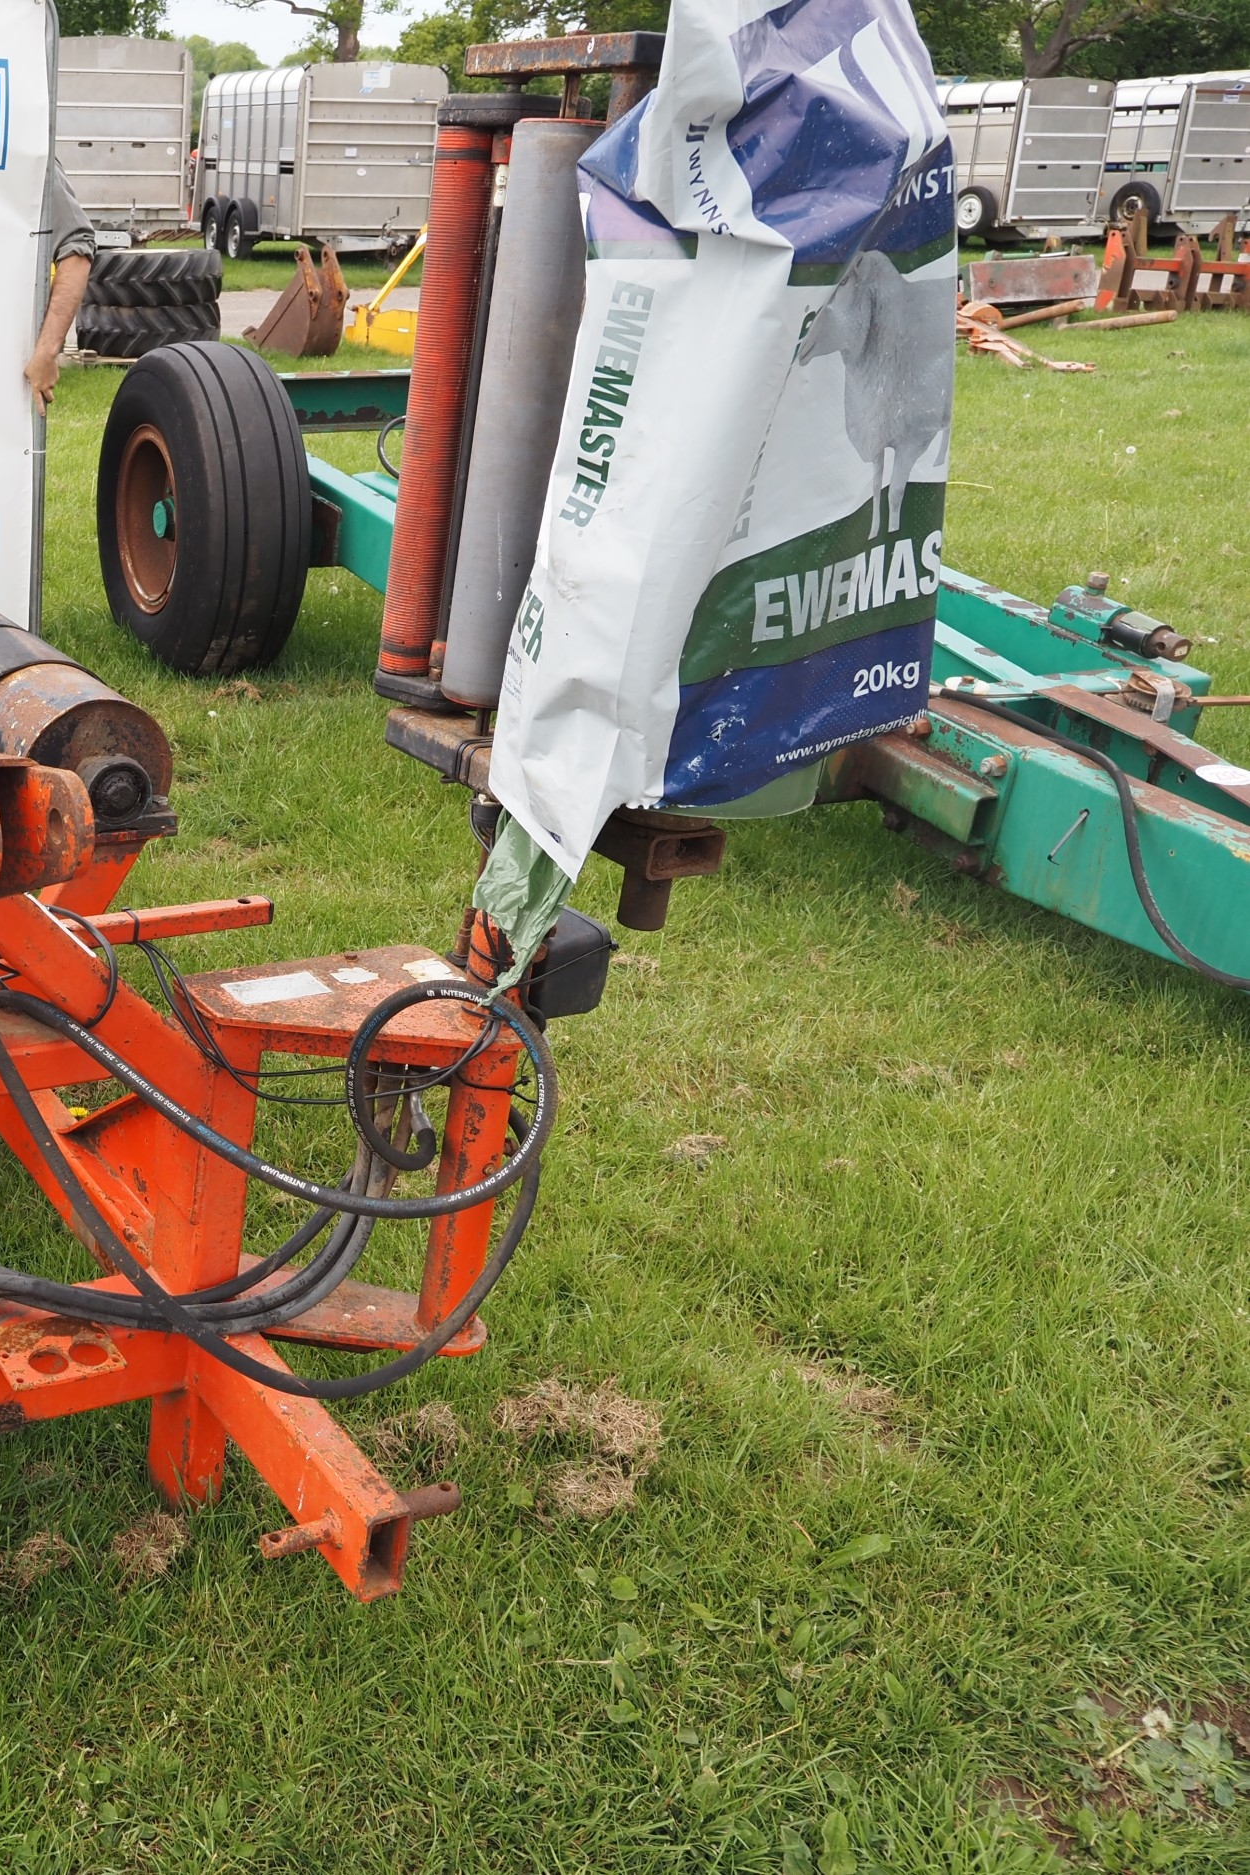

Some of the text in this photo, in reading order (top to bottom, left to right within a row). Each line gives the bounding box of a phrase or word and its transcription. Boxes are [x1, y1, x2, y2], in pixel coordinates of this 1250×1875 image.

[689, 147, 734, 237] WYNNS
[895, 164, 955, 208] NST
[559, 280, 655, 527] EWEMASTER
[853, 661, 920, 698] 20kg
[441, 989, 483, 1004] INTERPUM
[152, 1091, 165, 1102] ISO
[537, 1073, 545, 1107] EXCEEDS
[164, 1100, 191, 1121] EXCEEDS
[535, 1108, 543, 1122] ISO
[260, 1164, 307, 1190] INTERPUMP
[475, 1184, 484, 1192] 10
[485, 1177, 496, 1187] DN
